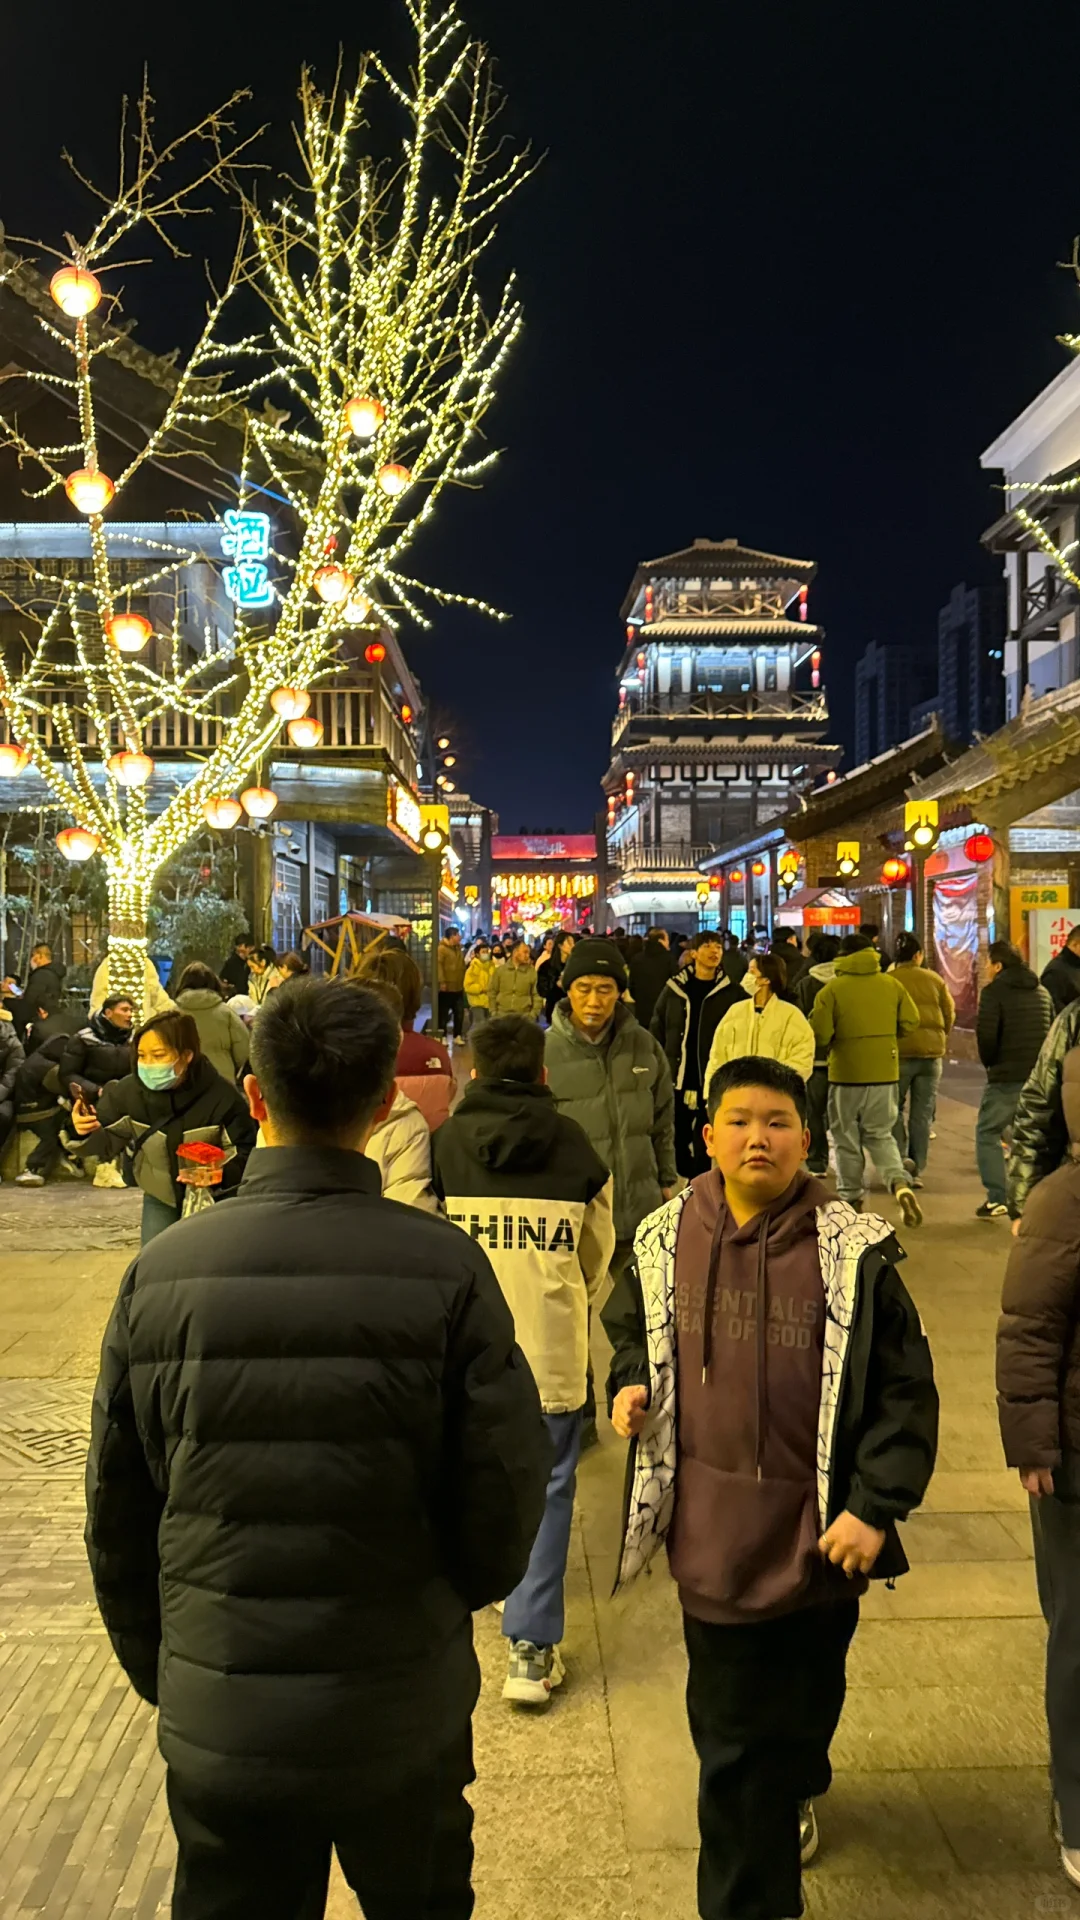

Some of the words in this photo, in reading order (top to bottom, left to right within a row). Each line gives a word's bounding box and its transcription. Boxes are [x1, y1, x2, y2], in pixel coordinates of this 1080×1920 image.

[447, 1214, 575, 1251] HINA
[728, 1317, 758, 1341] OF
[767, 1323, 811, 1349] GOD
